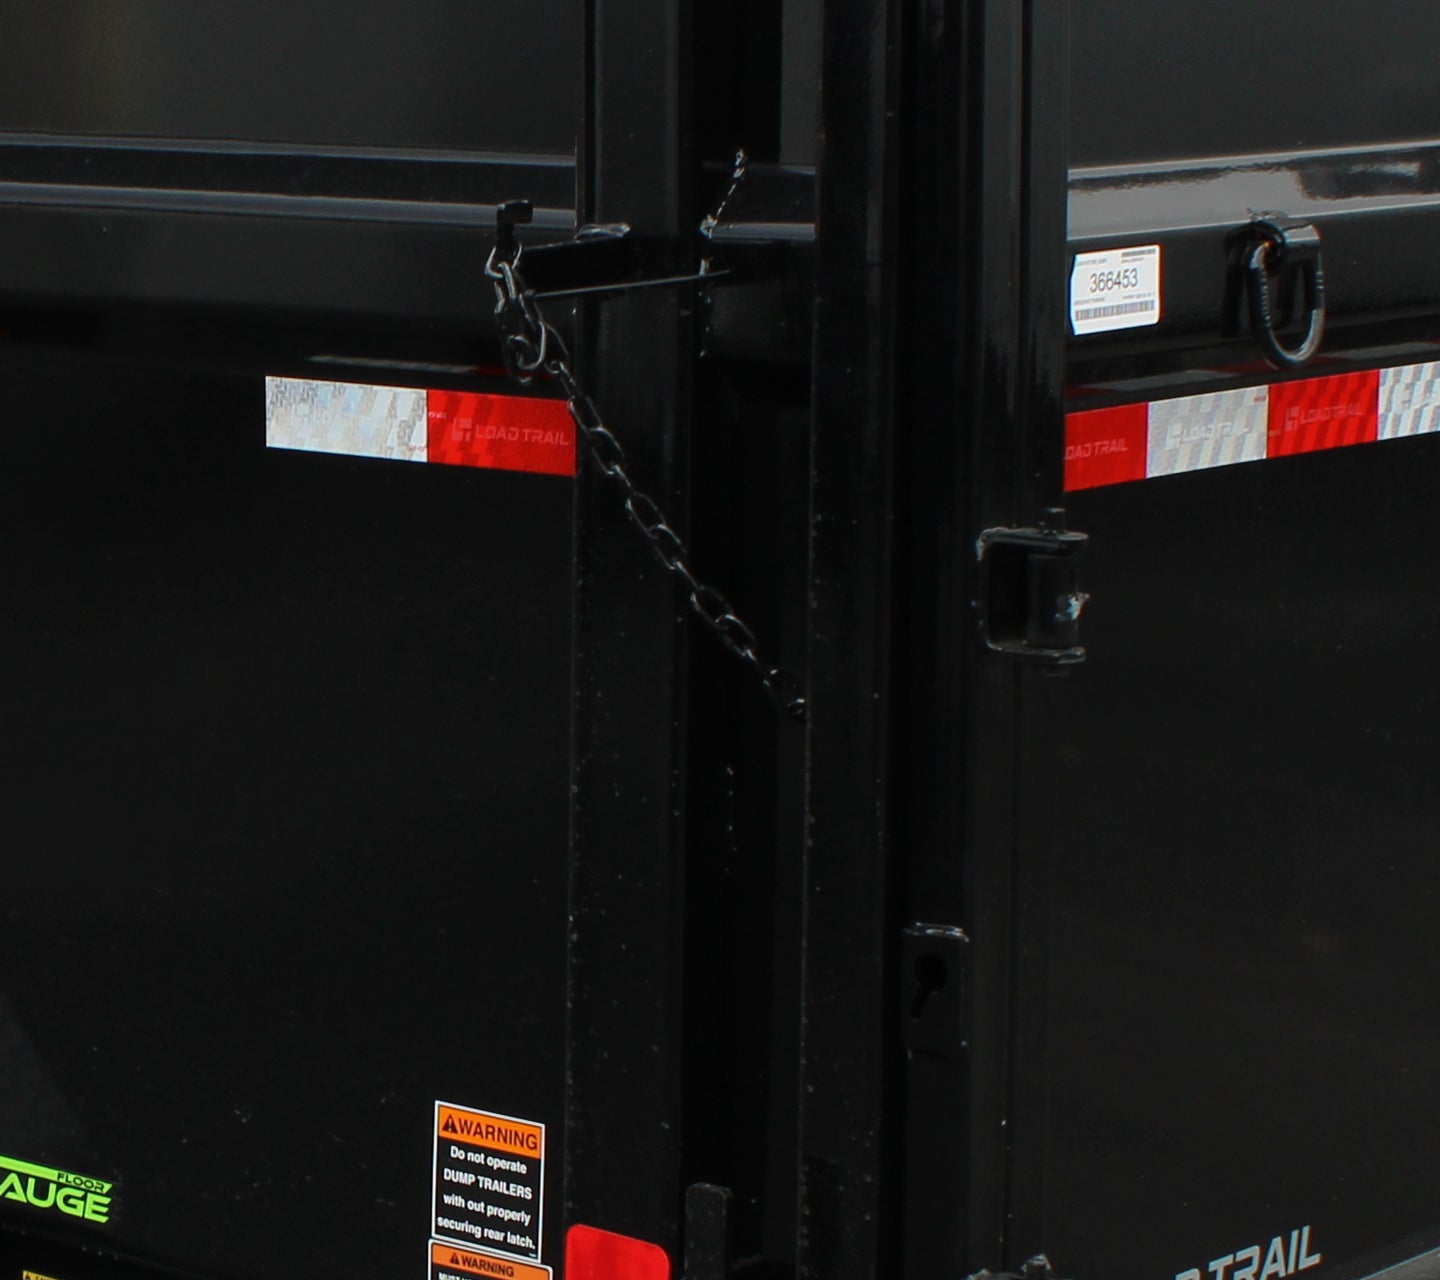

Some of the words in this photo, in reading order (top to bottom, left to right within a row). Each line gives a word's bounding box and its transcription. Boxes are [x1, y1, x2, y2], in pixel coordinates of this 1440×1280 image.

[1089, 267, 1139, 294] 366453
[1065, 443, 1092, 461] OAD
[458, 1117, 538, 1151] WARNING
[450, 1145, 465, 1160] Do
[467, 1151, 485, 1164] not
[486, 1156, 527, 1174] operate
[57, 1171, 105, 1193] FLOOR
[443, 1167, 476, 1186] DUMP
[477, 1175, 533, 1200] TRAILERS
[443, 1193, 465, 1208] with
[467, 1199, 485, 1213] out
[486, 1205, 531, 1227] properly
[437, 1216, 481, 1238] securing
[483, 1228, 505, 1242] rear
[507, 1232, 536, 1249] latch.
[461, 1254, 515, 1278] WARNING
